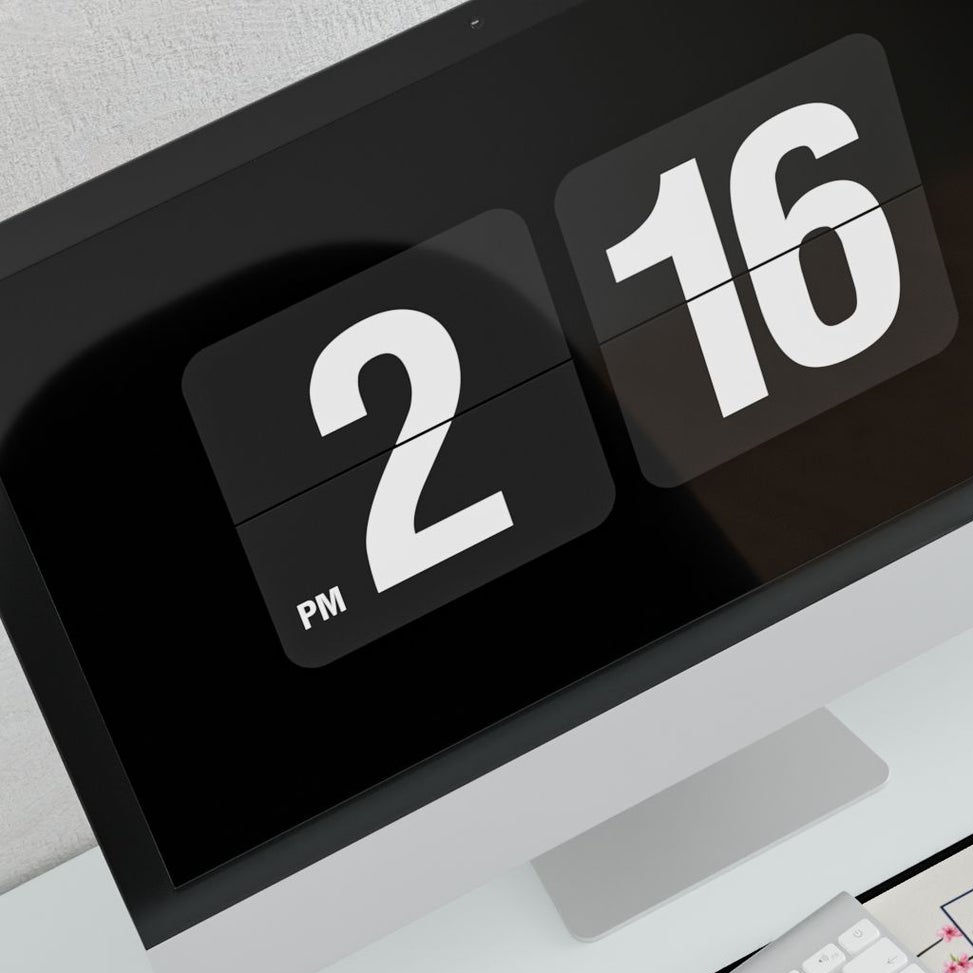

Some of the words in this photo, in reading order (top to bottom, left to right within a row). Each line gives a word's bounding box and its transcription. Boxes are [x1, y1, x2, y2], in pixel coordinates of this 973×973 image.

[605, 102, 901, 418] 16
[309, 309, 514, 594] 2
[296, 585, 347, 630] PM
